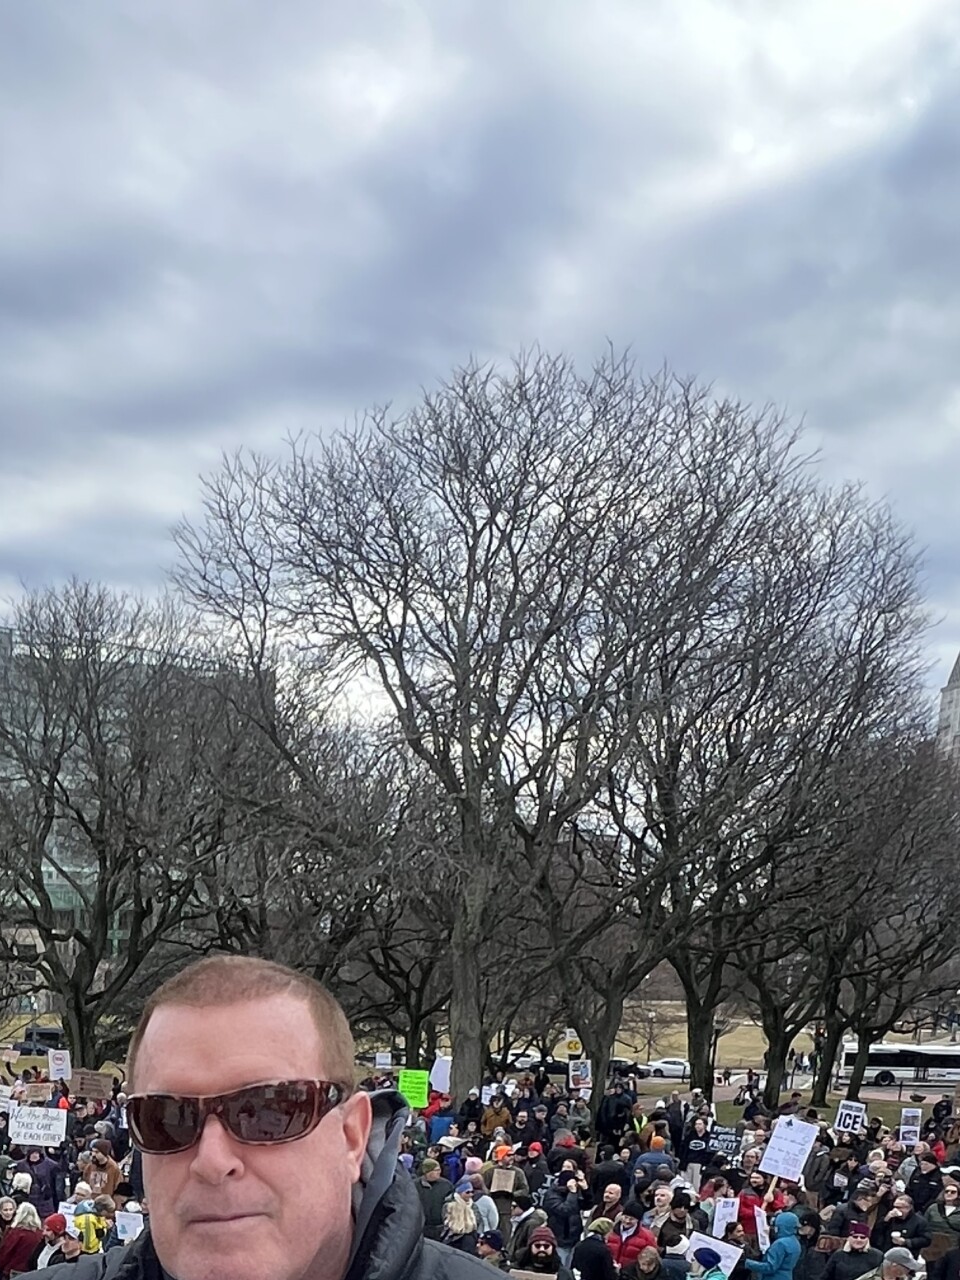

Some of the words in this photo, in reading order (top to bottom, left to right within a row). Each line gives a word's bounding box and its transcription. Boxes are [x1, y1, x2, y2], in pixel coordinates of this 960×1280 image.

[16, 1120, 35, 1130] TAKE
[36, 1122, 54, 1131] CARE
[837, 1112, 860, 1131] ICE
[23, 1131, 41, 1141] EACH
[42, 1133, 62, 1142] OTHER
